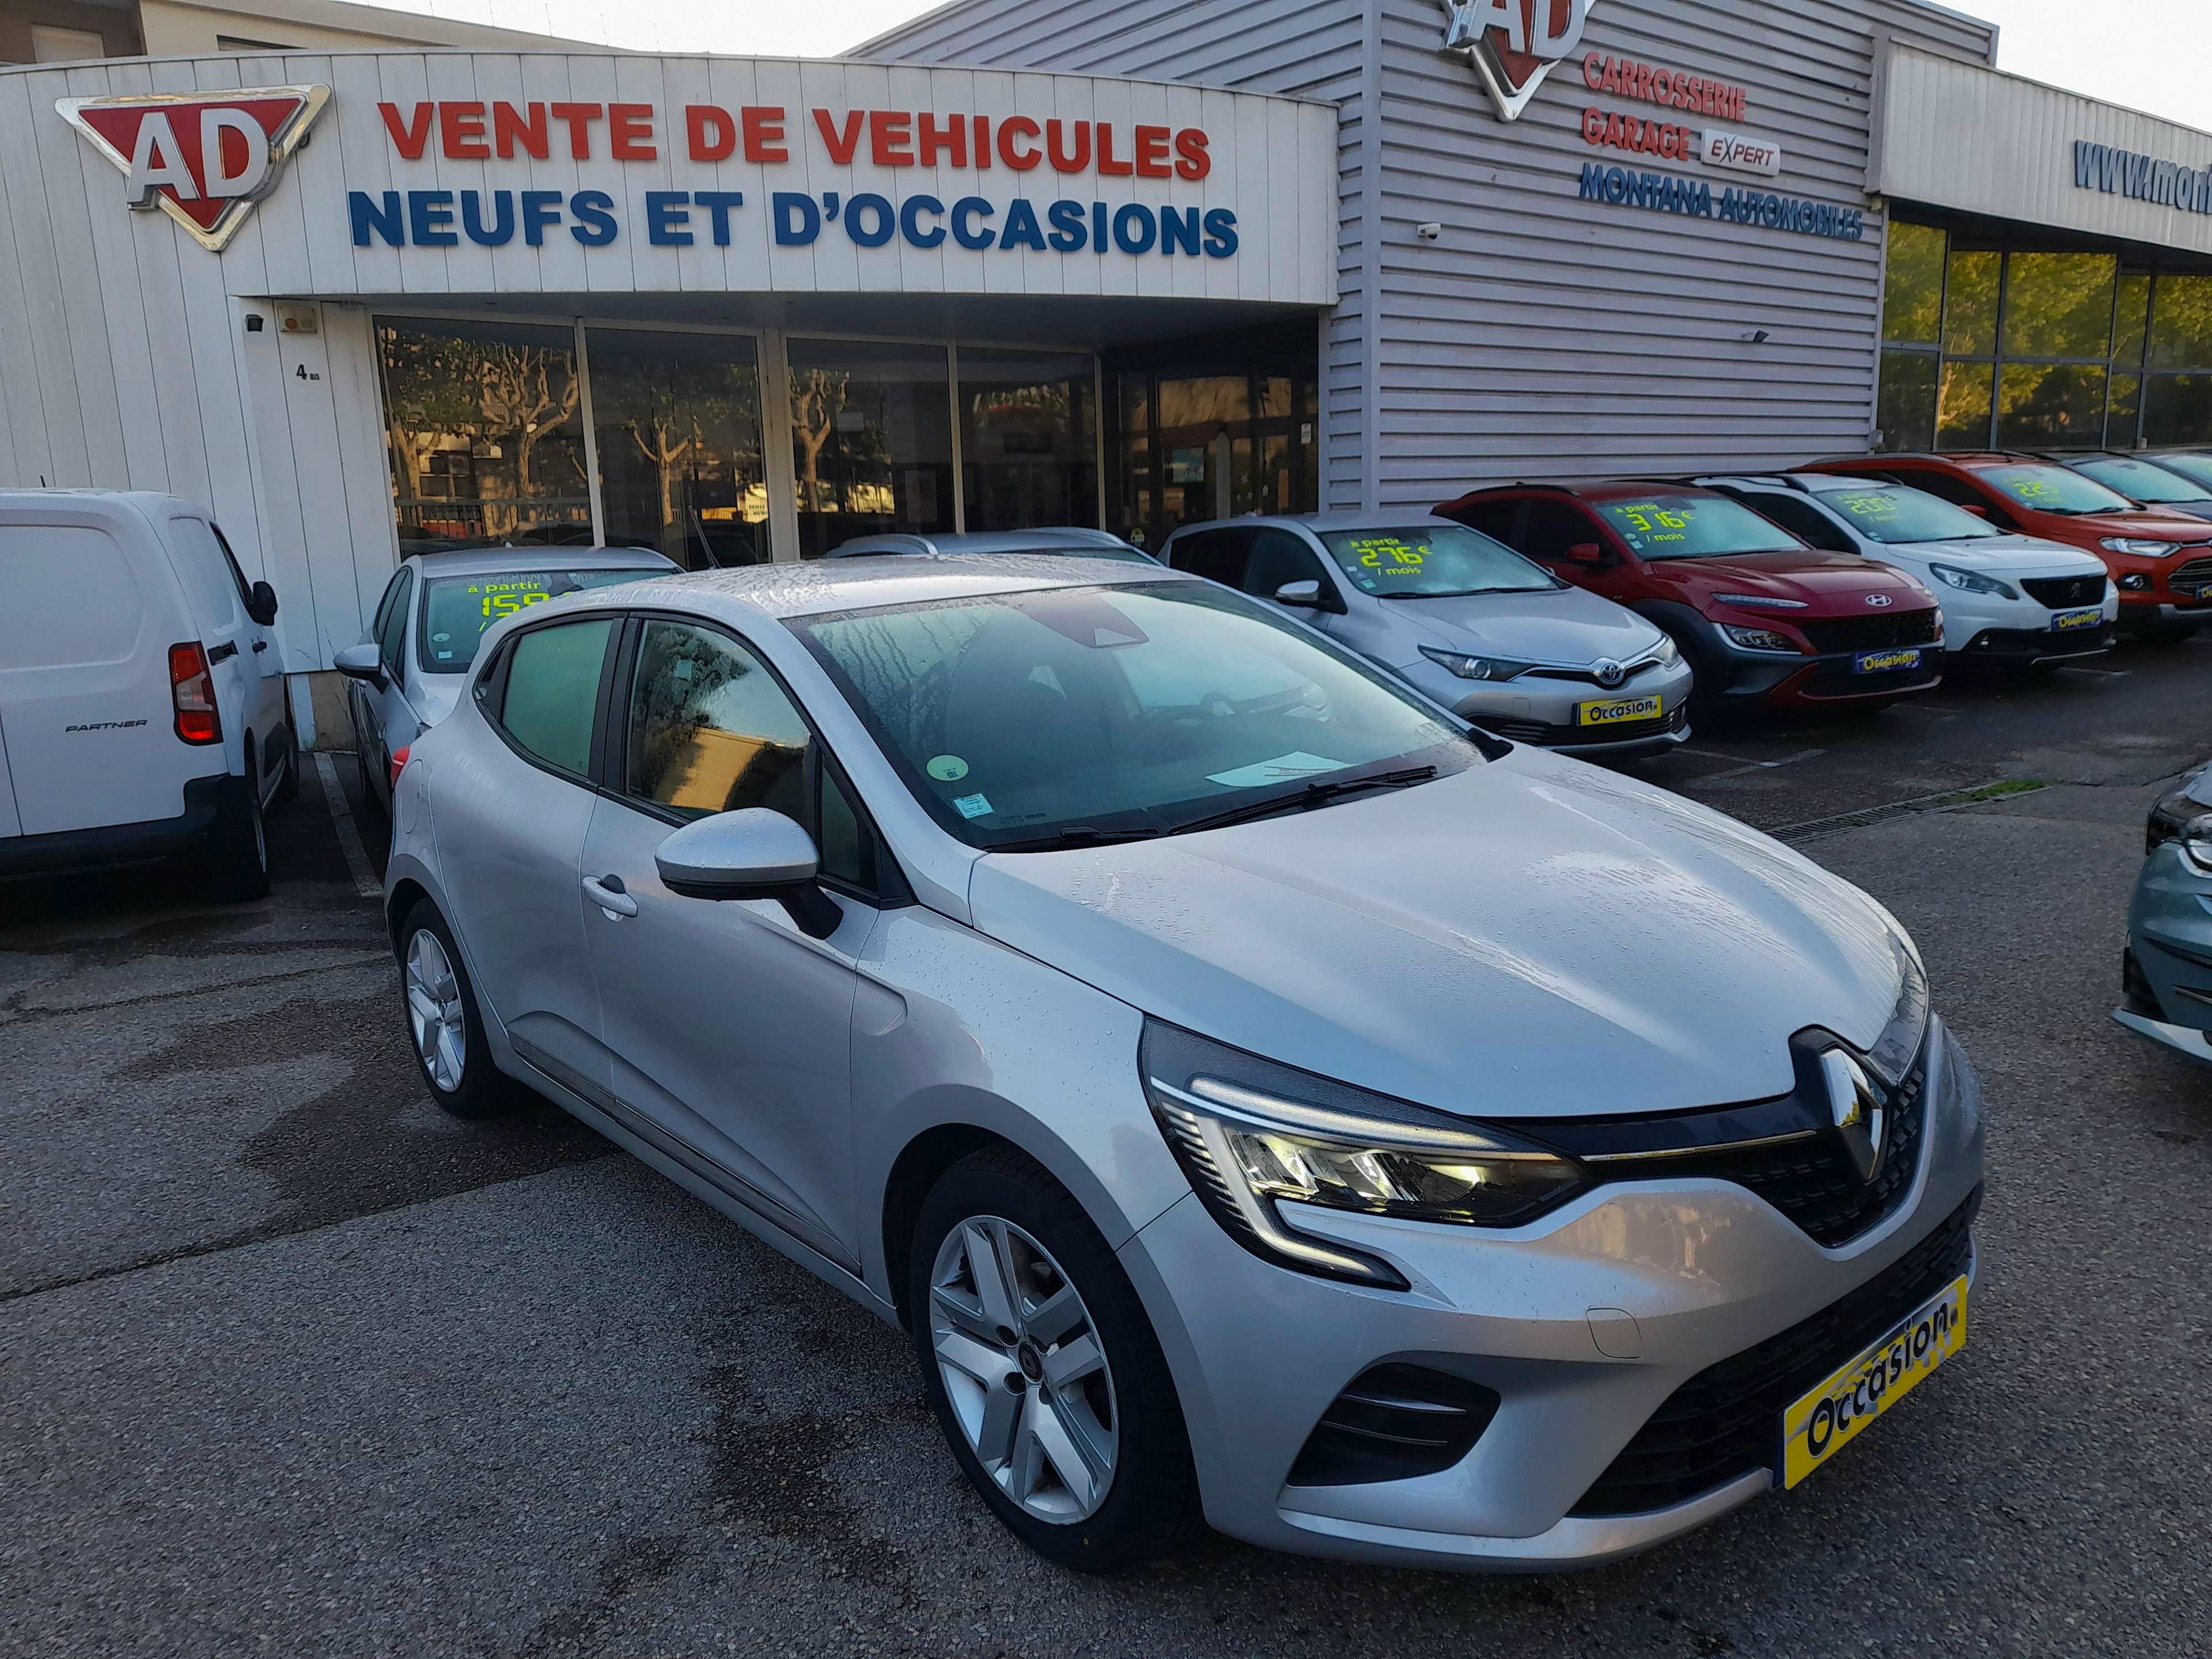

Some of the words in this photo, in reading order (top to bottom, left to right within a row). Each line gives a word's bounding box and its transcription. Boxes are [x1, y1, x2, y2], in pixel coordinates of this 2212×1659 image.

[1463, 0, 1586, 58] AD
[1584, 51, 1747, 122] CARROSSERIE
[377, 101, 657, 161] VENTE
[685, 104, 789, 162] DE
[812, 108, 1211, 180] VEHICULES
[1582, 106, 1691, 162] GARAGE
[1710, 135, 1775, 167] EXPERT
[127, 108, 271, 206] AD
[1579, 161, 1714, 218] MONTANA
[1718, 187, 1863, 241] AUTOMOBILES
[348, 190, 618, 246] NEUFS
[645, 191, 743, 246] ET
[772, 191, 1239, 258] D'OCCASIONS
[296, 363, 308, 380] 4
[1653, 532, 1686, 542] mois
[485, 581, 541, 594] partir
[1385, 566, 1422, 575] mois
[1863, 653, 1917, 671] Occasion
[65, 719, 148, 733] PARTNER
[1590, 699, 1653, 721] Occasion
[1807, 1302, 1949, 1459] Occasion
